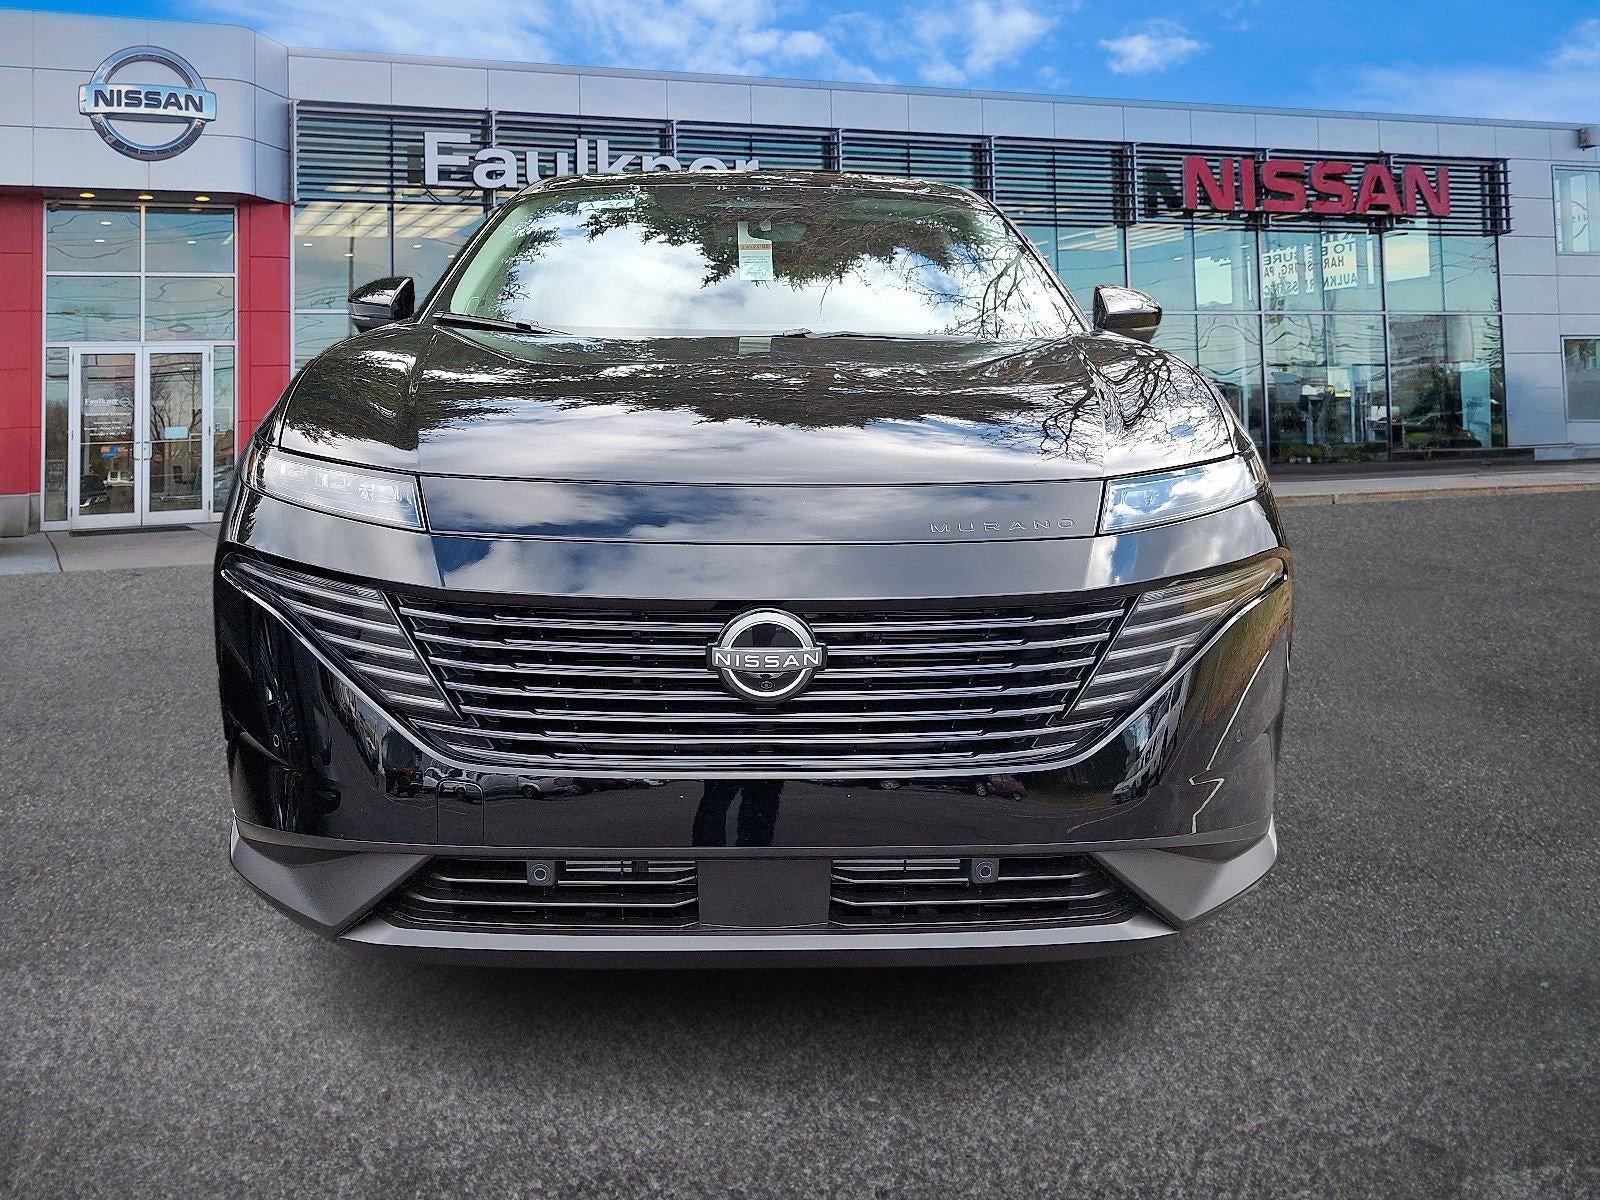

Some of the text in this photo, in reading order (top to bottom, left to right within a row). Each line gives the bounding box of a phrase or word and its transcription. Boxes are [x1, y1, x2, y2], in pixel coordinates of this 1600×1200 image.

[93, 89, 204, 113] NISSAN
[1182, 154, 1450, 216] NISSAN
[929, 518, 1075, 533] MURANO
[715, 652, 819, 668] NISSAN
